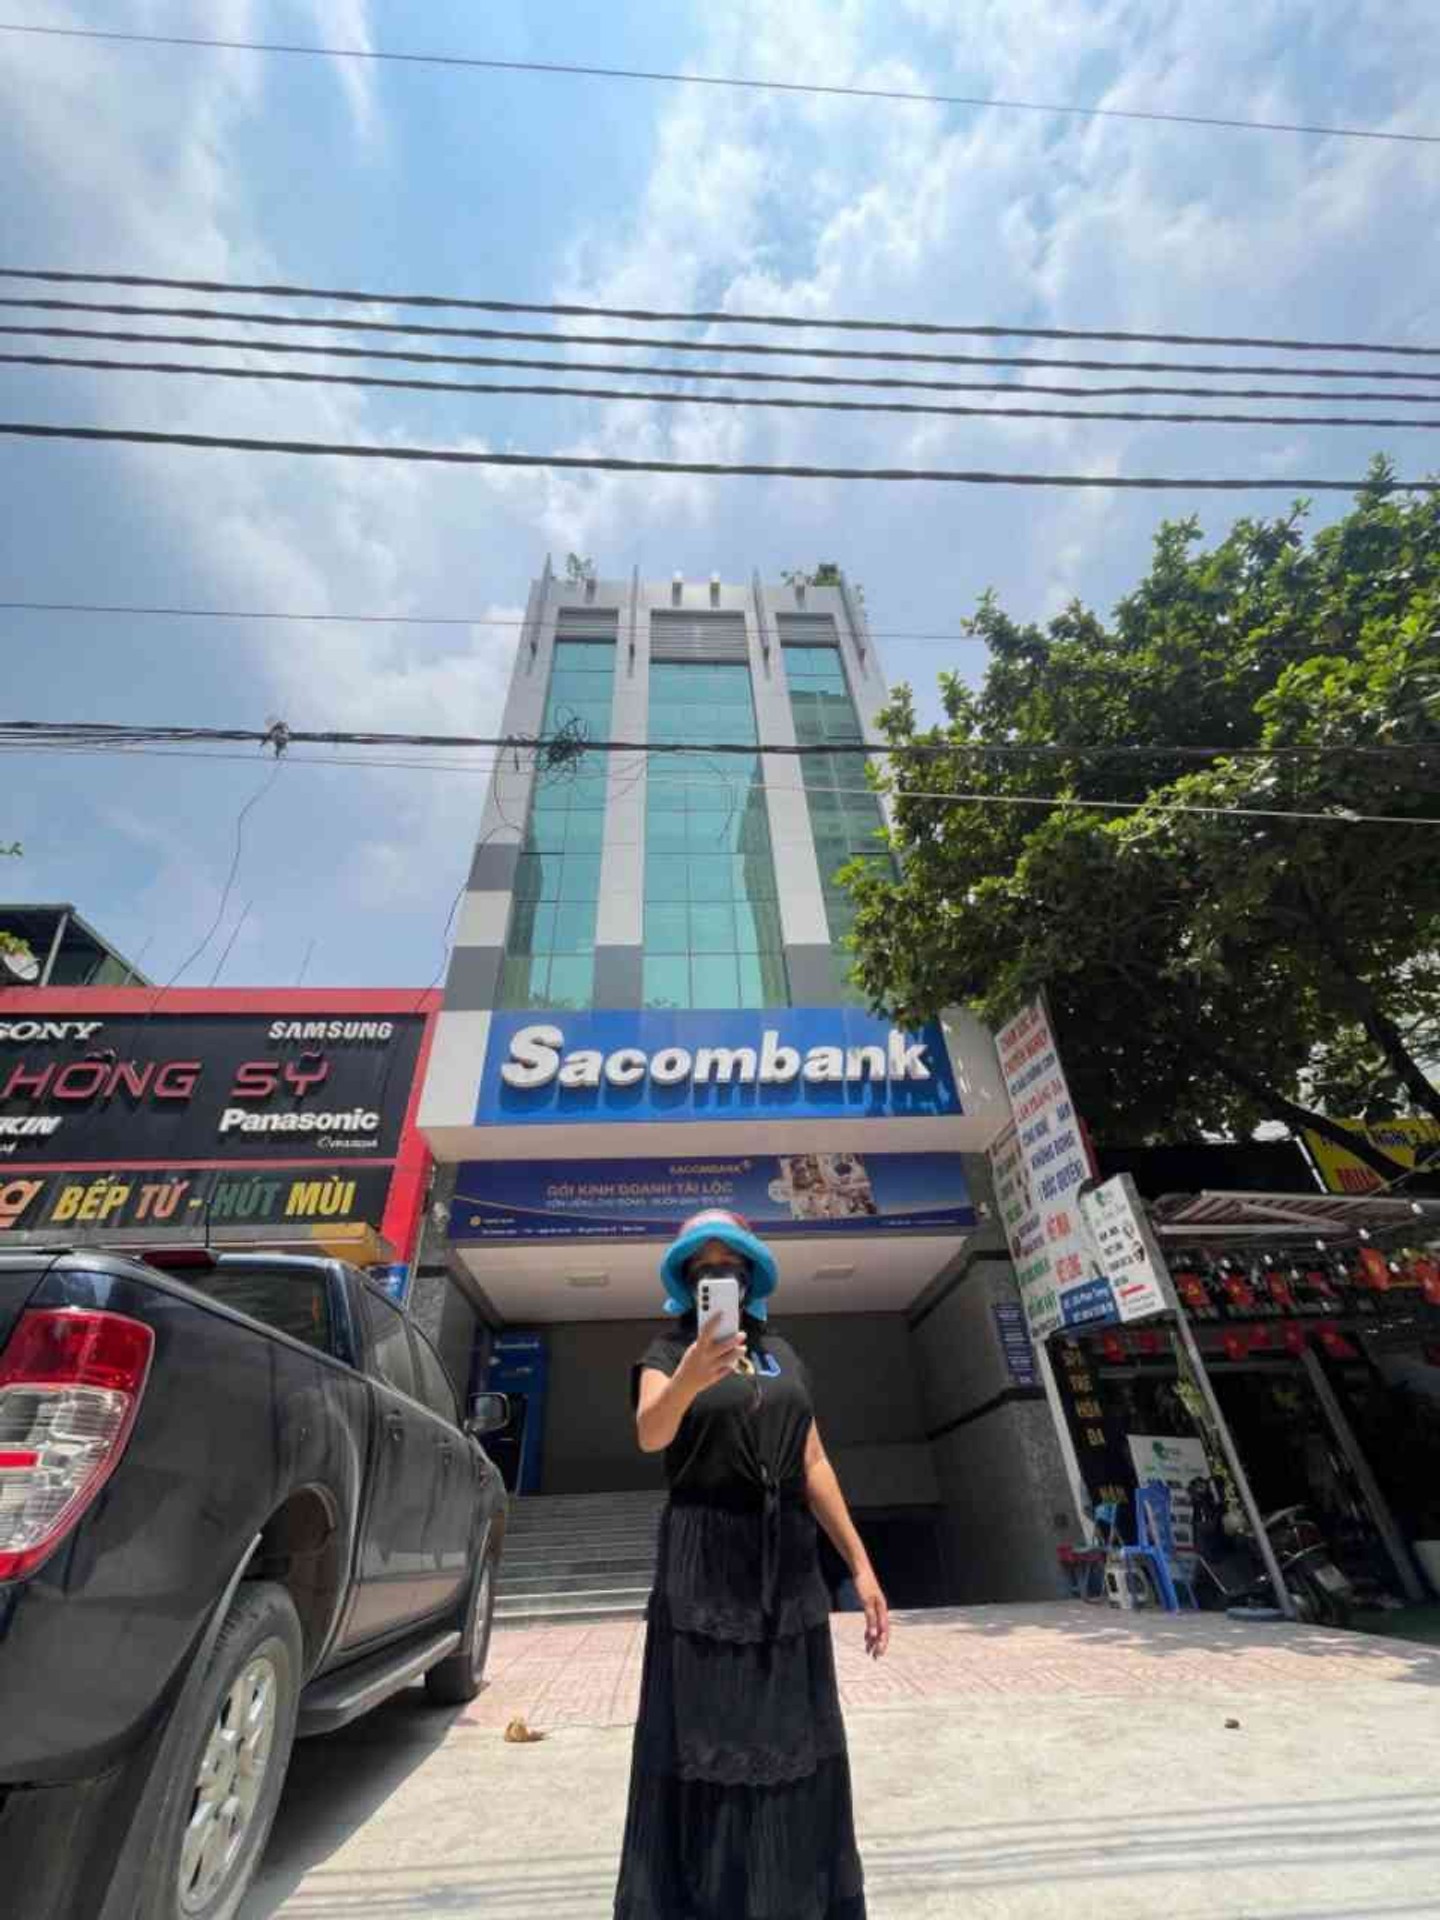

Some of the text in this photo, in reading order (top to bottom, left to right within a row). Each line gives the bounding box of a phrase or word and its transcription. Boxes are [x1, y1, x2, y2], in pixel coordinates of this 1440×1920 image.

[268, 1020, 394, 1040] SAMSUNG
[0, 1047, 330, 1098] HỒNG SỸ
[501, 1024, 931, 1088] Sacombank
[218, 1107, 380, 1133] Panasonic
[51, 1174, 132, 1221] BẾP
[210, 1175, 282, 1217] HÚT
[284, 1175, 358, 1217] MÙI
